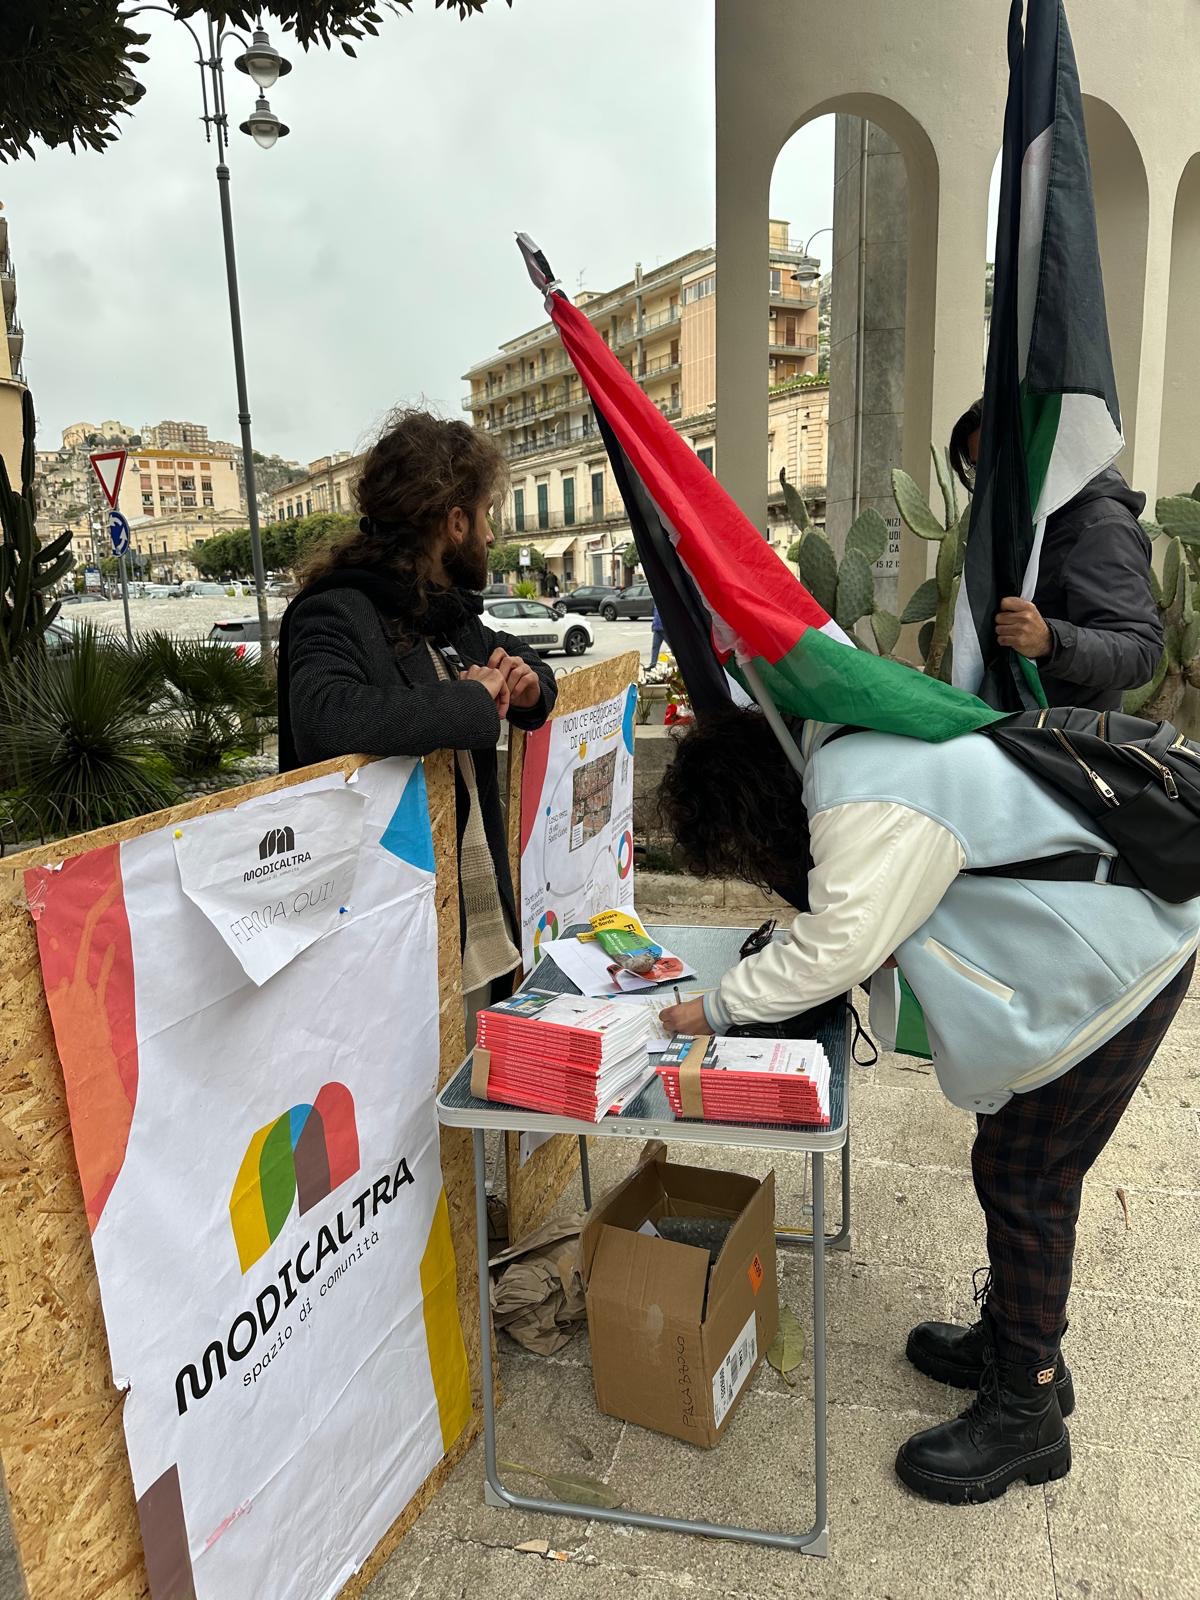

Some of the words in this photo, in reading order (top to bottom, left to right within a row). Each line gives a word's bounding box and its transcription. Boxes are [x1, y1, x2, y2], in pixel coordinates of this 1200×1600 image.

[563, 717, 578, 733] NON
[243, 851, 312, 883] MODICALTRA
[230, 901, 287, 945] FIRMA
[293, 879, 335, 917] QUI!
[175, 1157, 415, 1417] MODICALTRA
[243, 1325, 293, 1387] spazio
[299, 1297, 313, 1322] di
[319, 1230, 380, 1297] comunità
